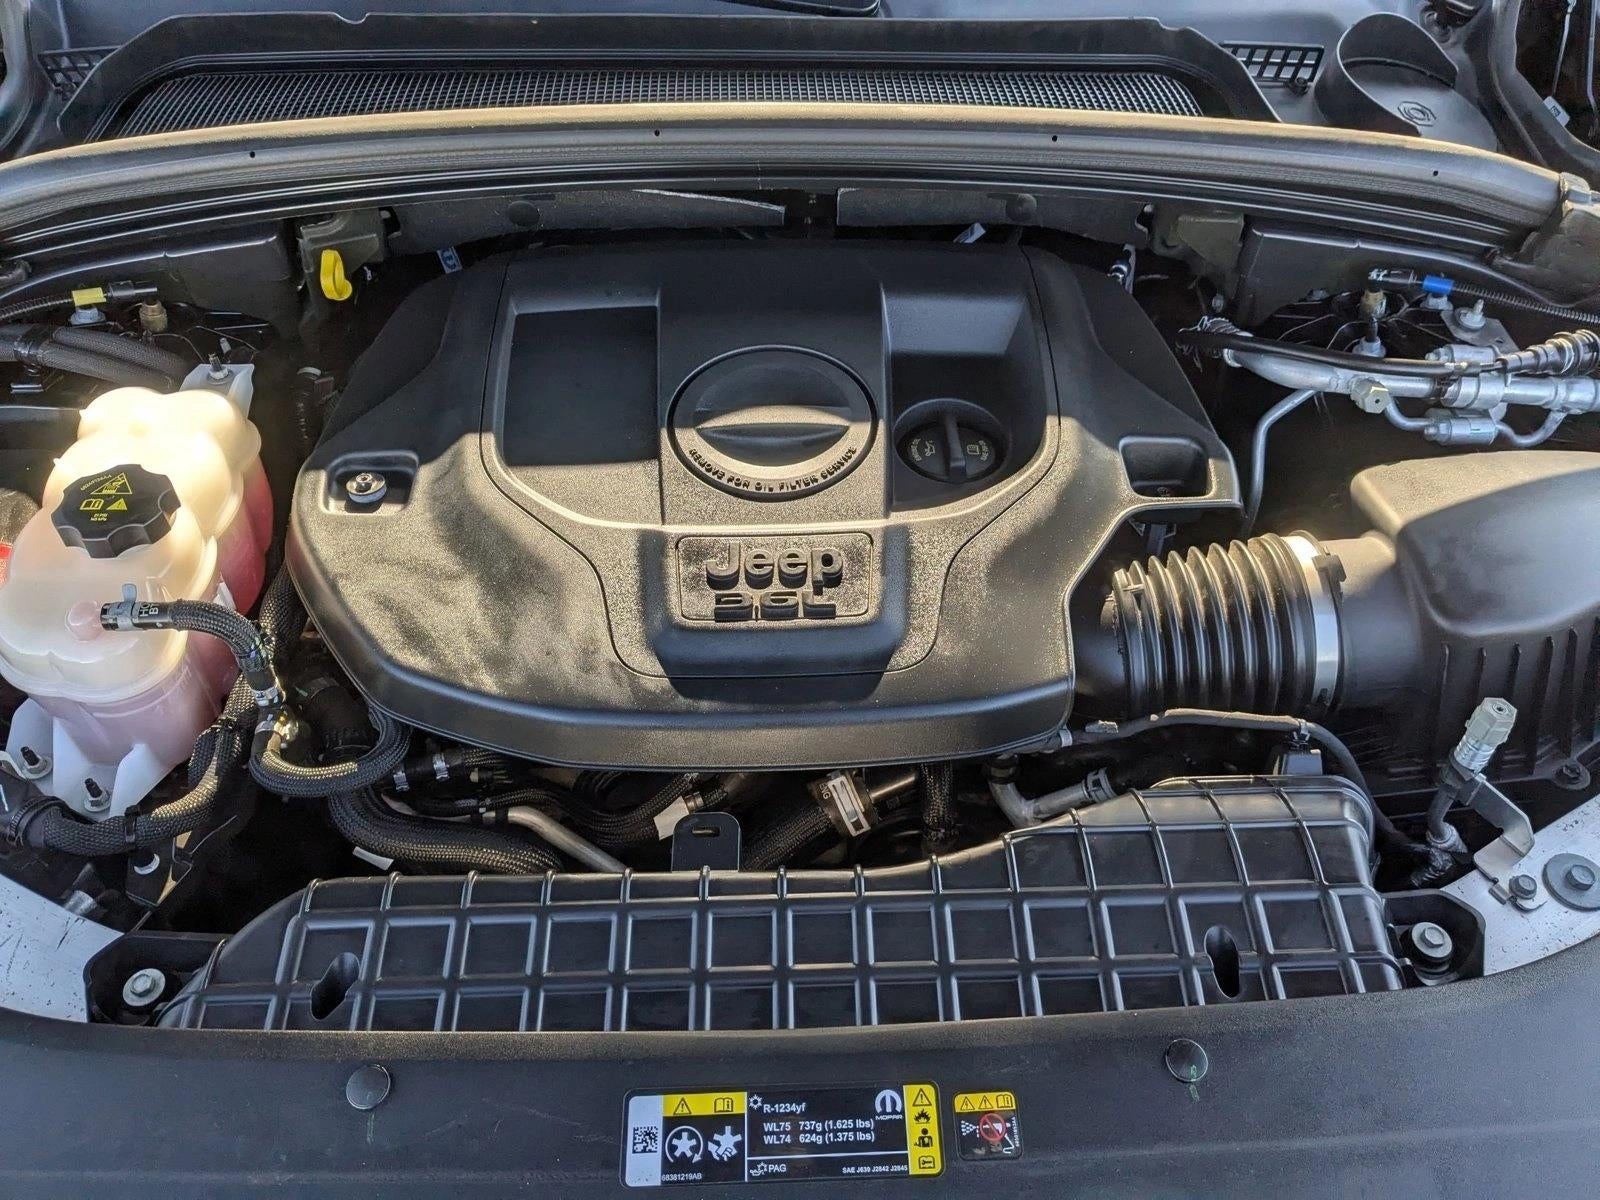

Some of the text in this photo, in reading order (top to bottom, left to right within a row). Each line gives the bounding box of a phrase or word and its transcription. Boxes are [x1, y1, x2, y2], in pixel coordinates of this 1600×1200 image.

[688, 446, 858, 493] REMOVE FOR OIL FILTER SERVICE
[705, 541, 844, 595] Jeep
[763, 1102, 806, 1114] R-1234yf
[763, 1118, 875, 1132] WL75 737g (1.625 lbs)
[763, 1131, 875, 1144] WL74 624g (1.375 lbs)
[768, 1163, 787, 1173] PAG
[842, 1166, 856, 1174] SAE
